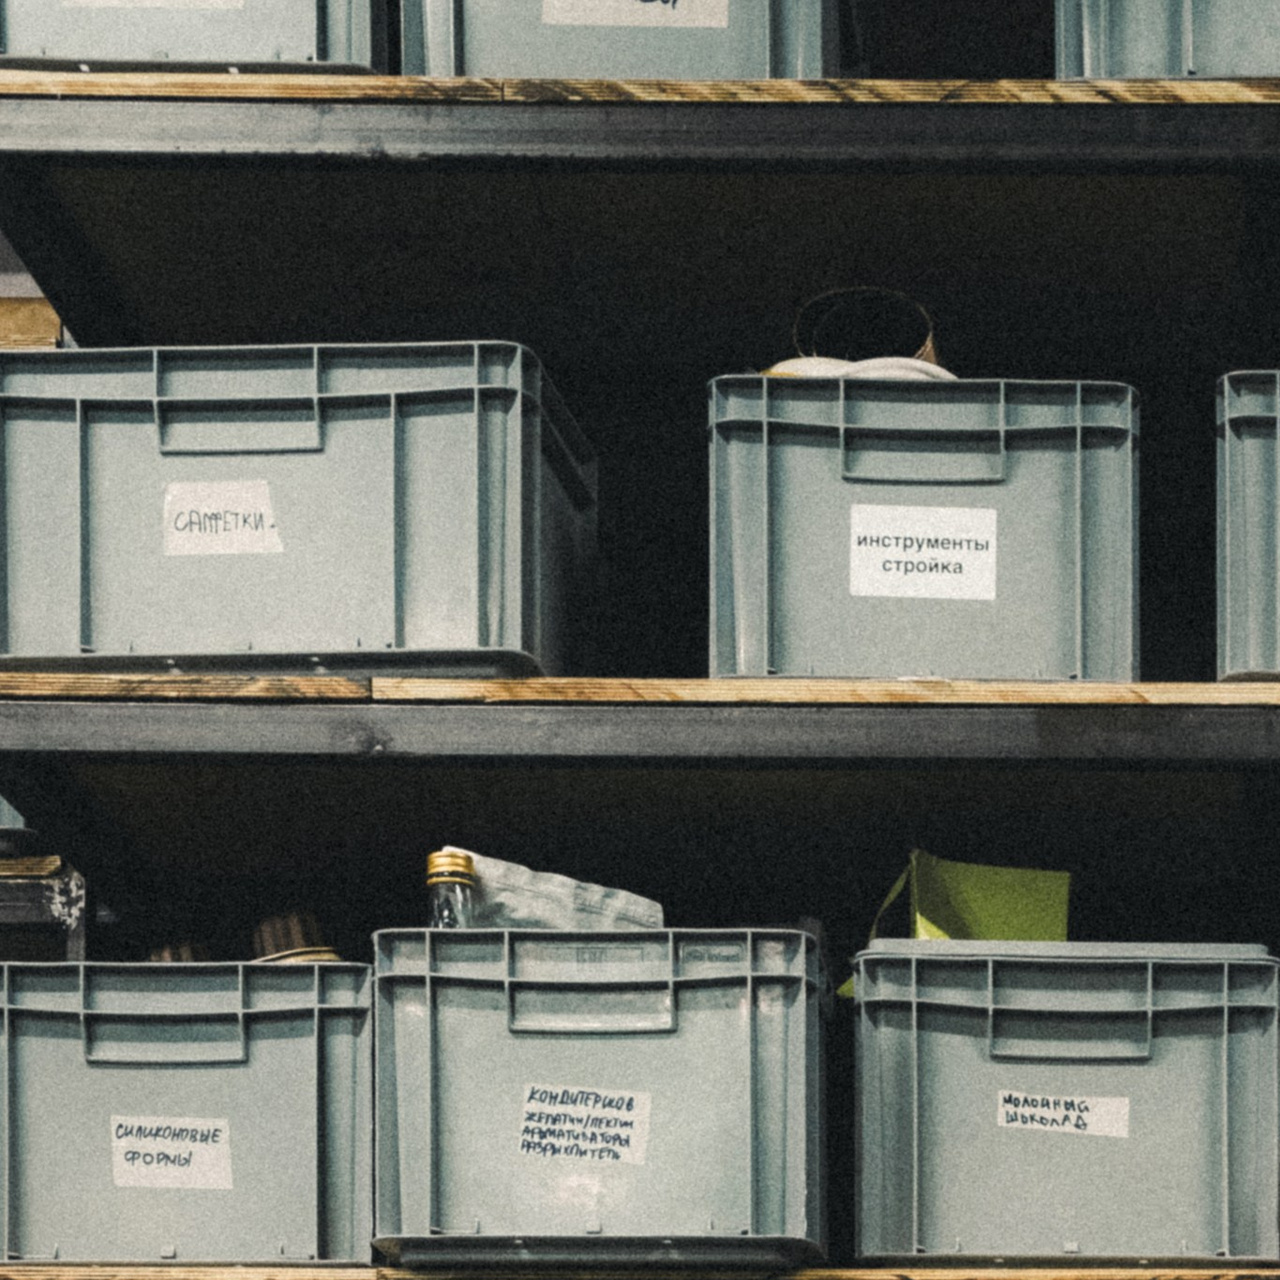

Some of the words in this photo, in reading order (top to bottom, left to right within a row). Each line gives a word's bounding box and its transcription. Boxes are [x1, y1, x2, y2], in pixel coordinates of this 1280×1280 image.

[856, 535, 990, 553] инструменты
[882, 557, 964, 575] стройка
[1005, 1111, 1088, 1131] ШОКОЛАД
[124, 1150, 193, 1167] ФОРМЫ
